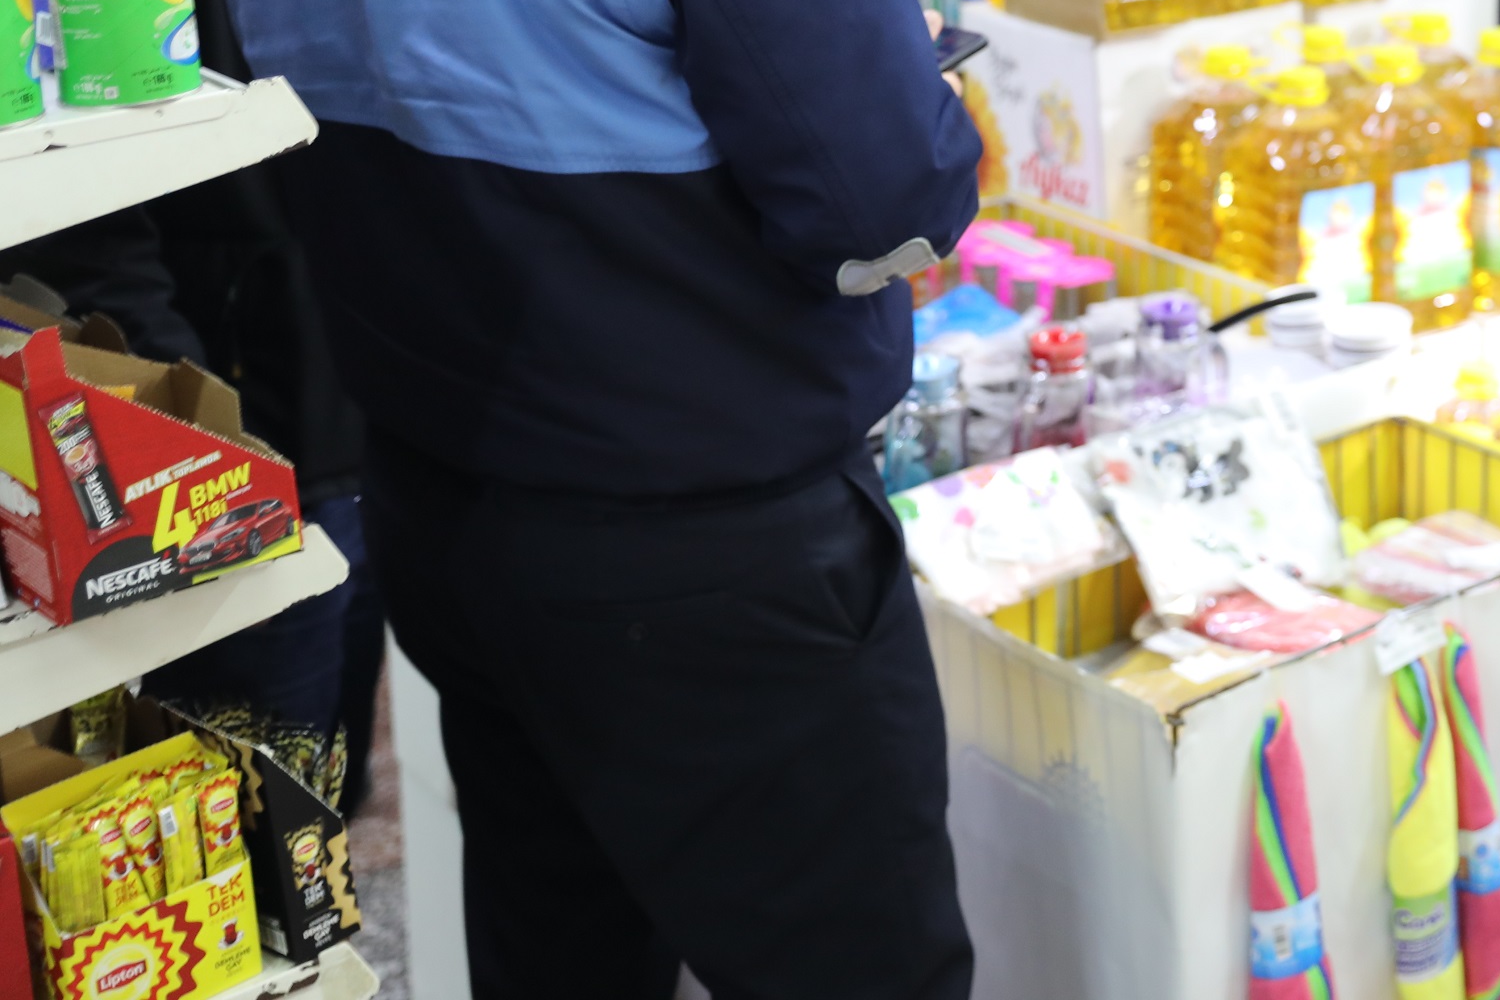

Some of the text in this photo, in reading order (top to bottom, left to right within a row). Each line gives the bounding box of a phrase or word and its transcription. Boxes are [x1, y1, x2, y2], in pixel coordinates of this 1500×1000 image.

[189, 461, 251, 510] BMW
[152, 480, 199, 554] 4
[193, 498, 228, 526] 118i
[206, 872, 243, 901] TEK
[208, 889, 246, 917] DEM
[99, 962, 145, 991] Lipton
